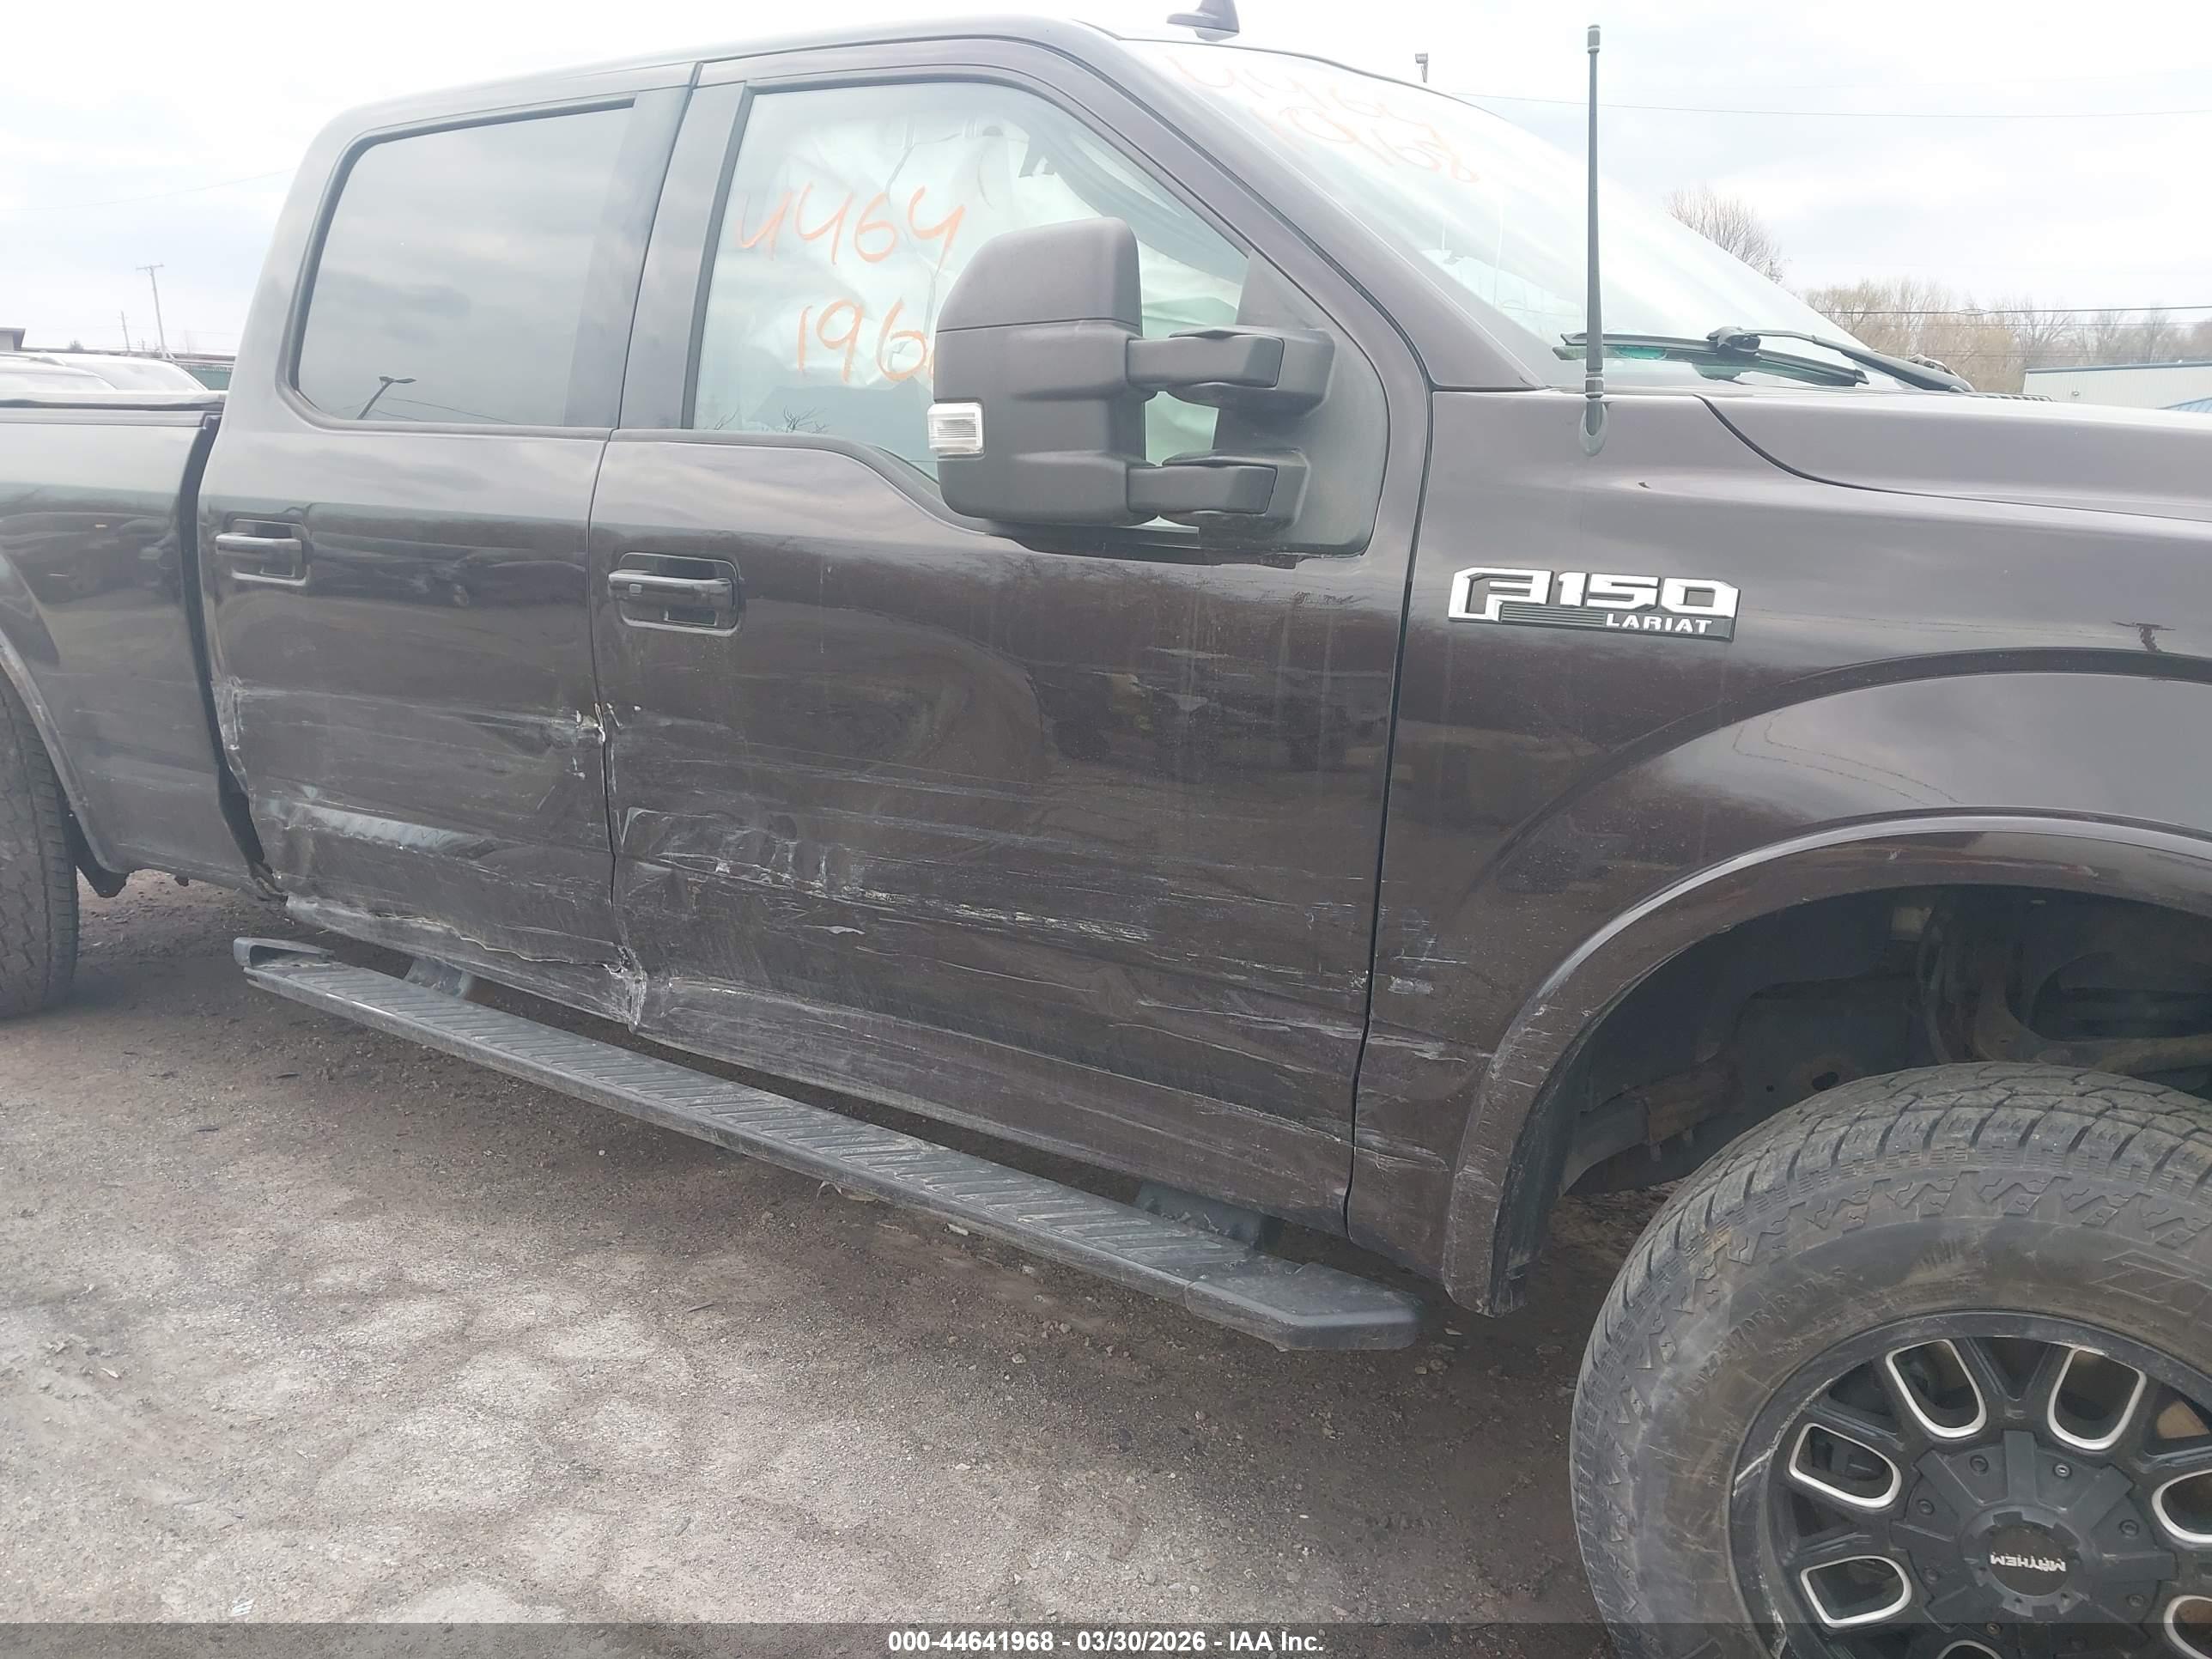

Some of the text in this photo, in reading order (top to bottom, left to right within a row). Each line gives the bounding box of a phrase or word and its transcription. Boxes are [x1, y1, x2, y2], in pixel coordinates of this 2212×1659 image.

[738, 181, 965, 281] 4464
[798, 297, 933, 383] 196
[1605, 612, 1713, 635] LARIAT
